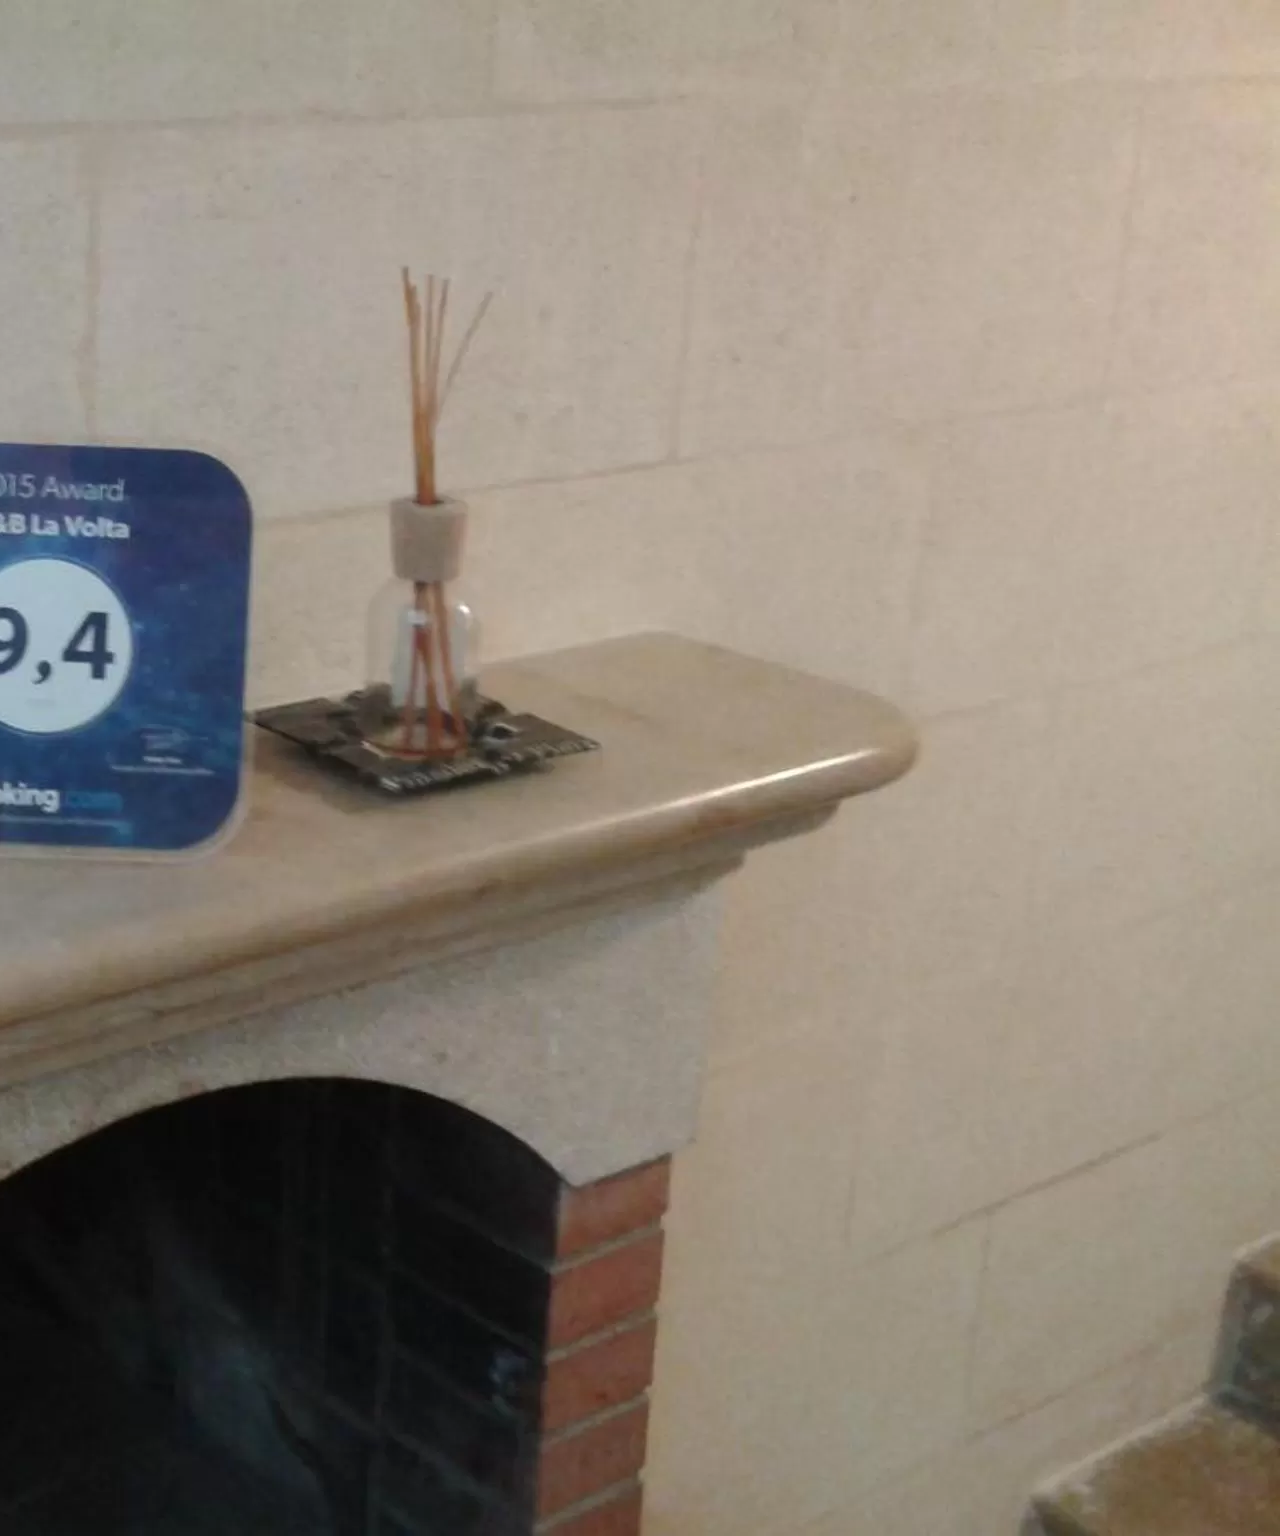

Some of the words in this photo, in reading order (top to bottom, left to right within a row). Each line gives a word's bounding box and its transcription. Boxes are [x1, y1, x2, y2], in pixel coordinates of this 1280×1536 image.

[41, 475, 125, 501] Award
[30, 514, 61, 536] La
[64, 516, 131, 539] Volta
